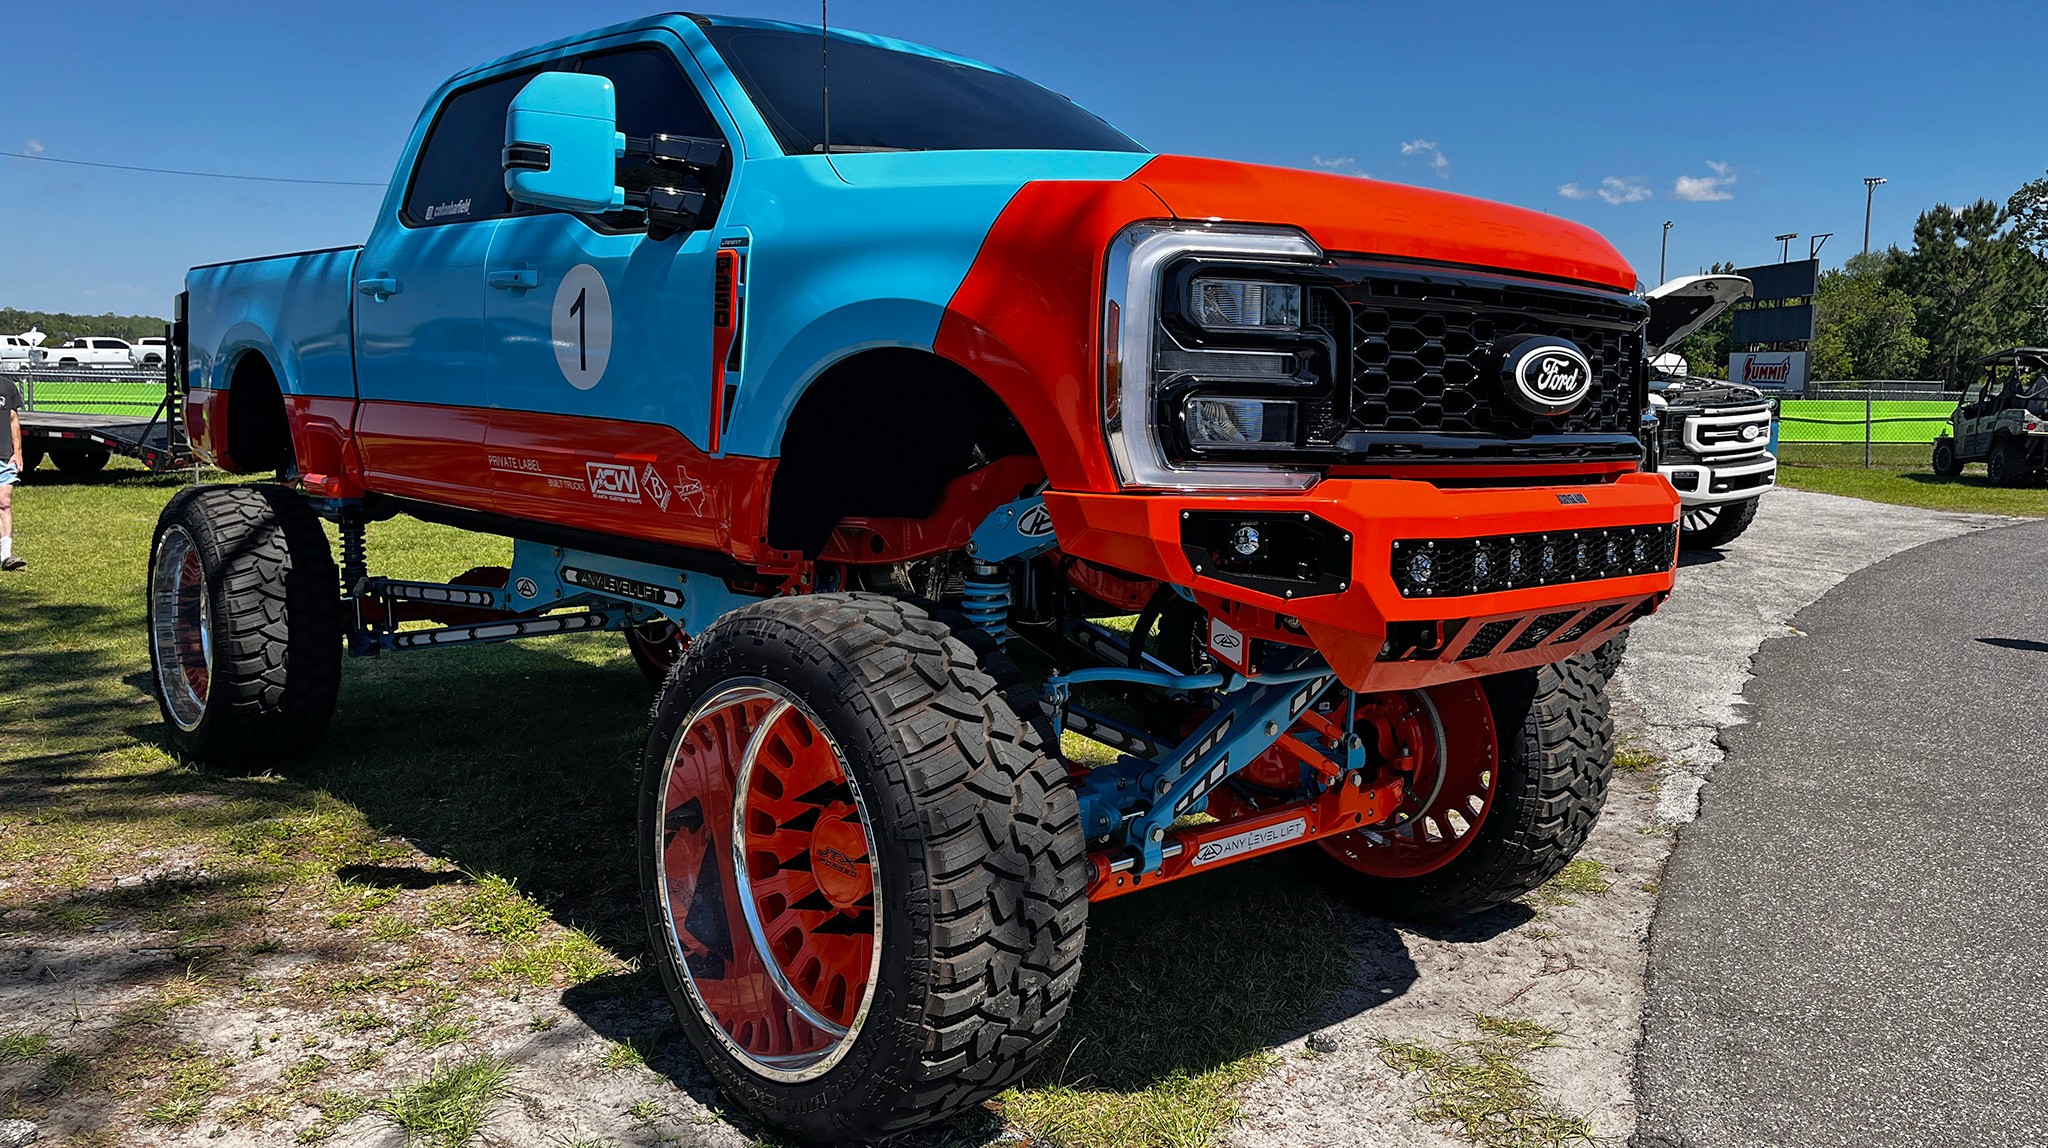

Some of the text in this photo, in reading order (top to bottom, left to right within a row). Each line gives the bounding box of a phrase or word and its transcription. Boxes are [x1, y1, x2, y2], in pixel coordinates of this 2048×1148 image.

[569, 286, 587, 371] 1
[1537, 357, 1579, 391] Ford
[1744, 355, 1789, 384] SUMMIT
[487, 454, 542, 472] PRIVATE LABEL
[547, 478, 586, 492] BUILT TRUCKS
[593, 467, 635, 493] ACW
[650, 476, 663, 499] B
[1223, 823, 1301, 853] ANY LEVEL LIFT
[816, 846, 856, 870] JTX
